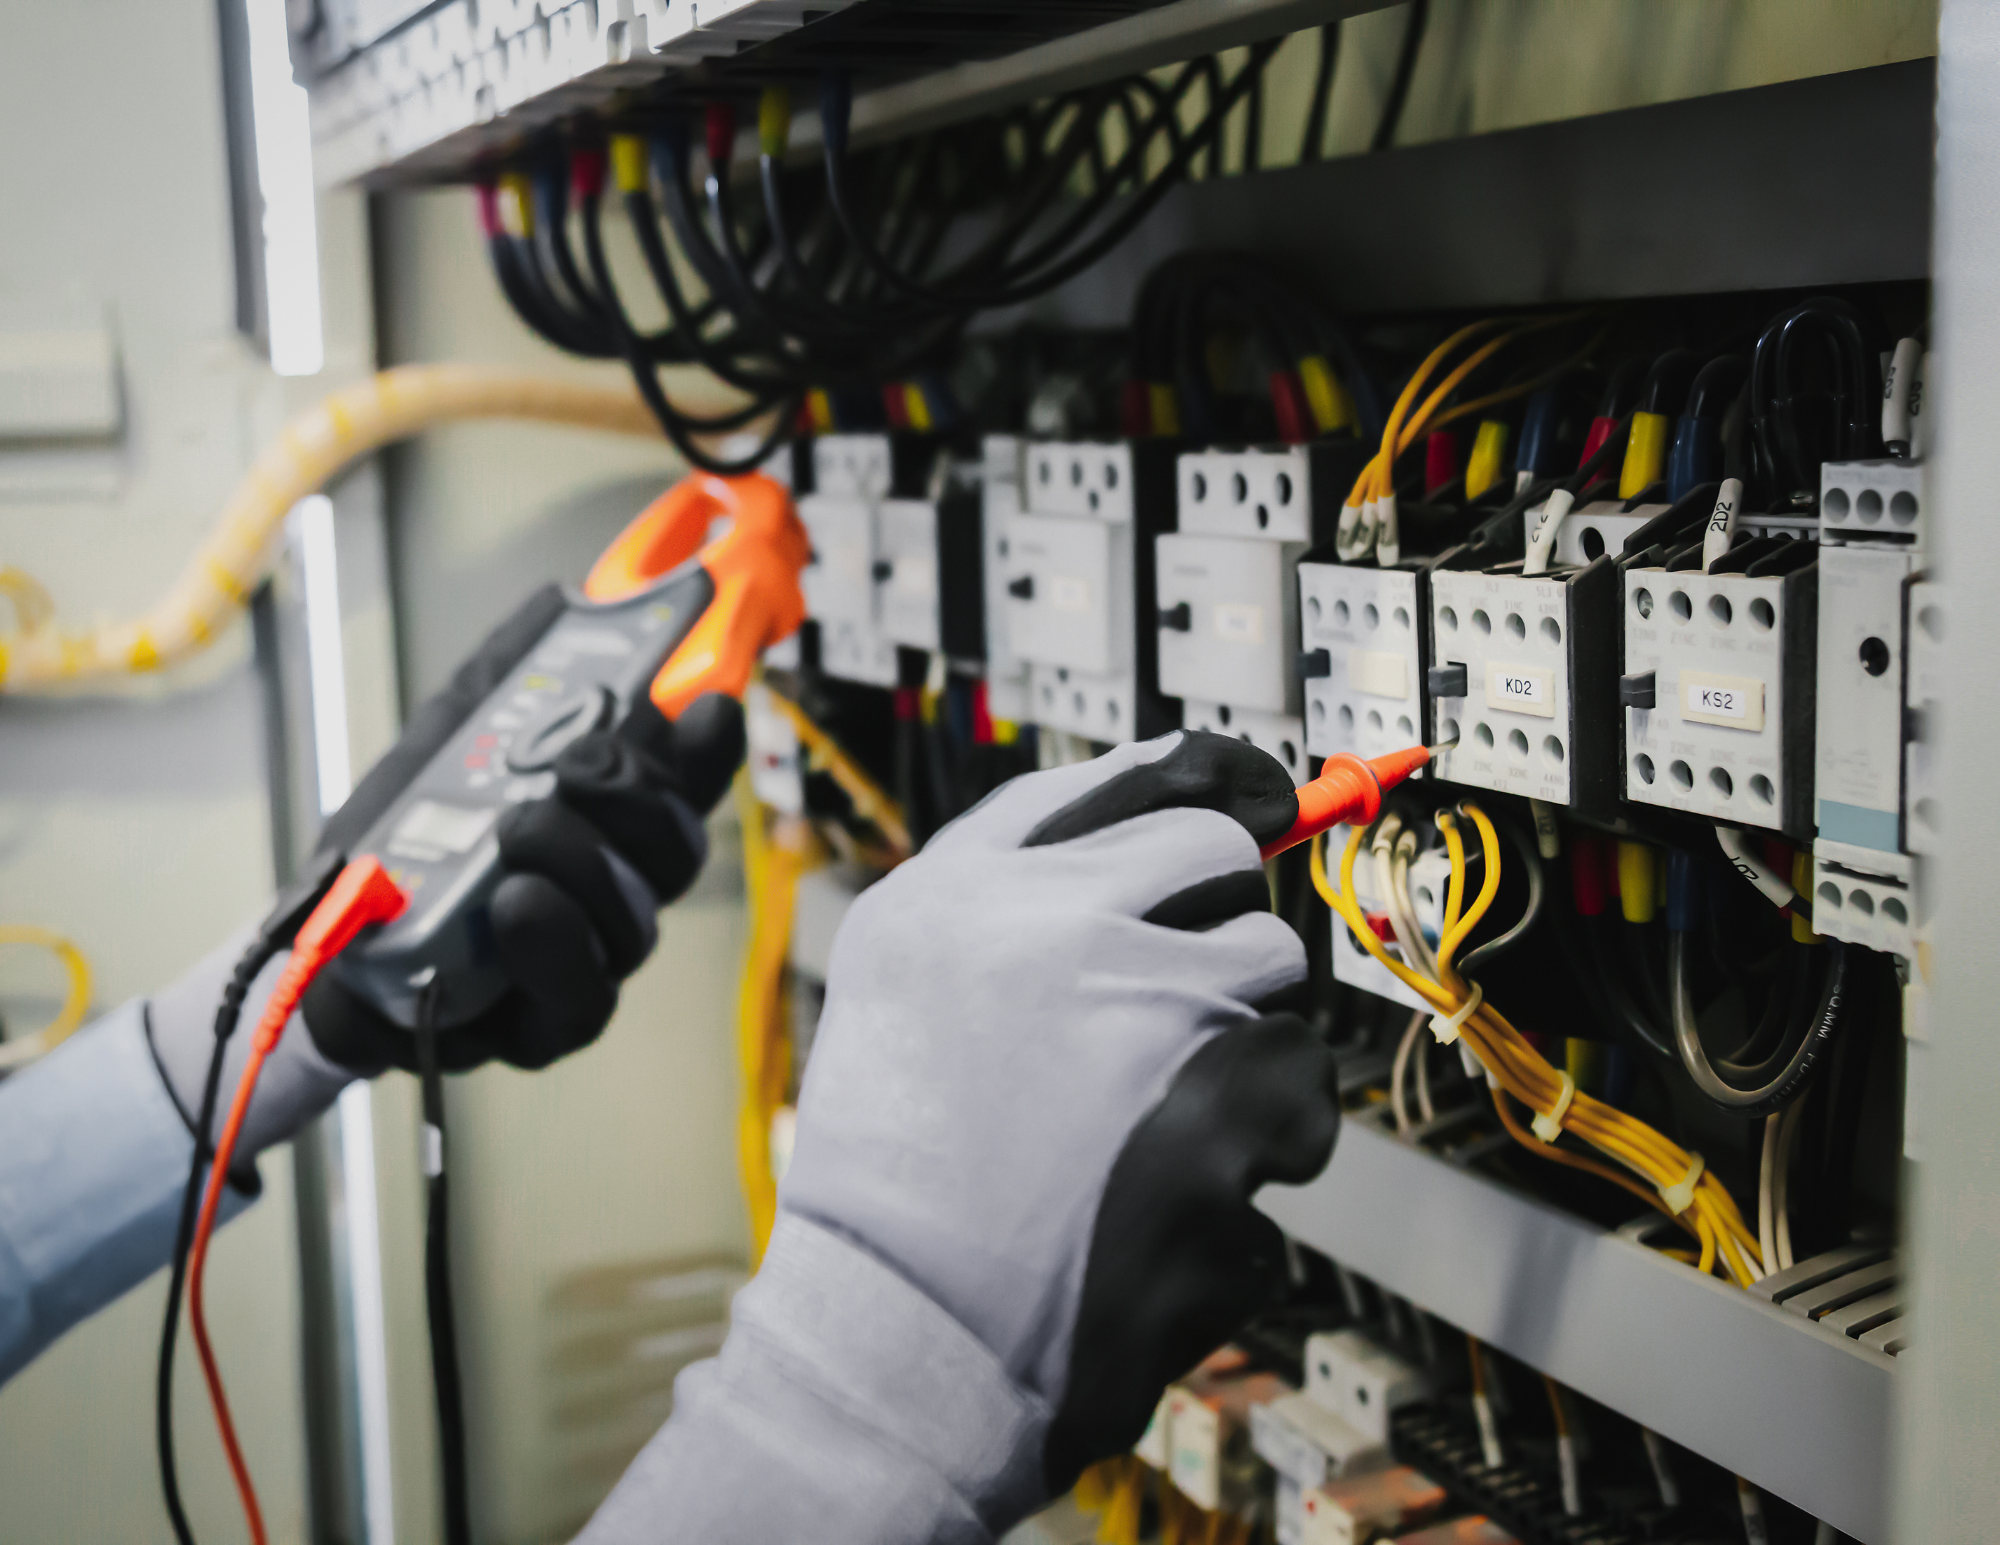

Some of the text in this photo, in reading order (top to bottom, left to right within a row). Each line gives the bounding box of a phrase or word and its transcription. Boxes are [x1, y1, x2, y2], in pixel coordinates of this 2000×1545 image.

[1710, 501, 1732, 531] 2D2
[1505, 677, 1532, 696] KD2
[1702, 690, 1733, 709] KS2
